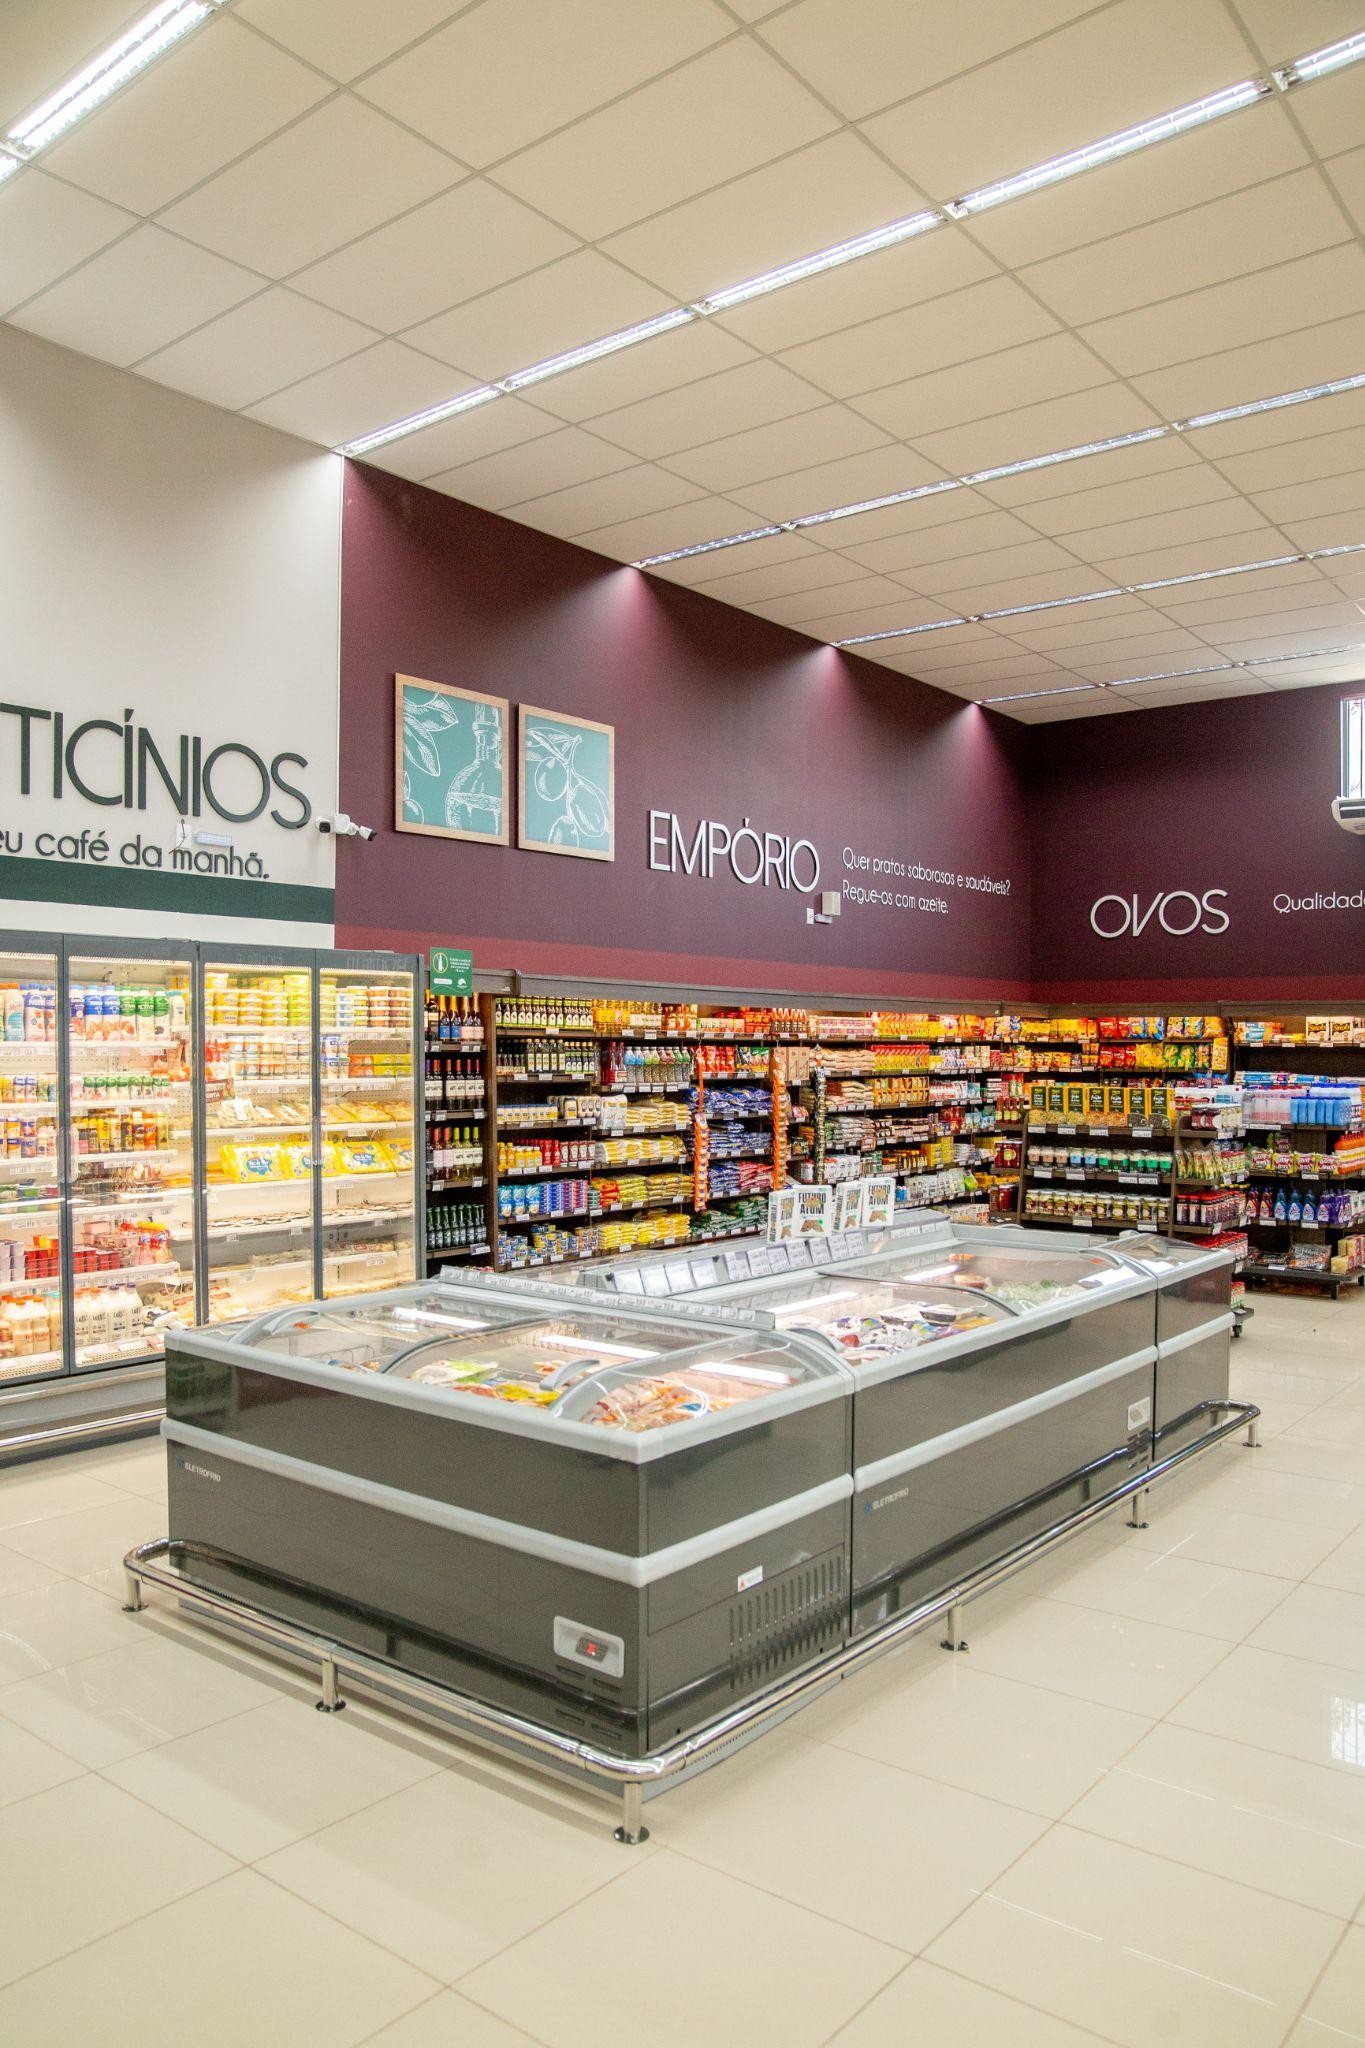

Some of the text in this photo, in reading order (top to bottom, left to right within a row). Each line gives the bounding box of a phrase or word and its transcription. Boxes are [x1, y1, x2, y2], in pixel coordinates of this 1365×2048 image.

[0, 830, 23, 853] u
[35, 829, 110, 862] café
[120, 834, 163, 867] da
[649, 809, 821, 893] EMPÓRIO
[842, 846, 1011, 896] Quer pratos saborosos e saudáveis?
[842, 879, 949, 914] Regue-os com azeite.
[1089, 888, 1231, 939] OVOS
[1273, 889, 1365, 914] Qualidad
